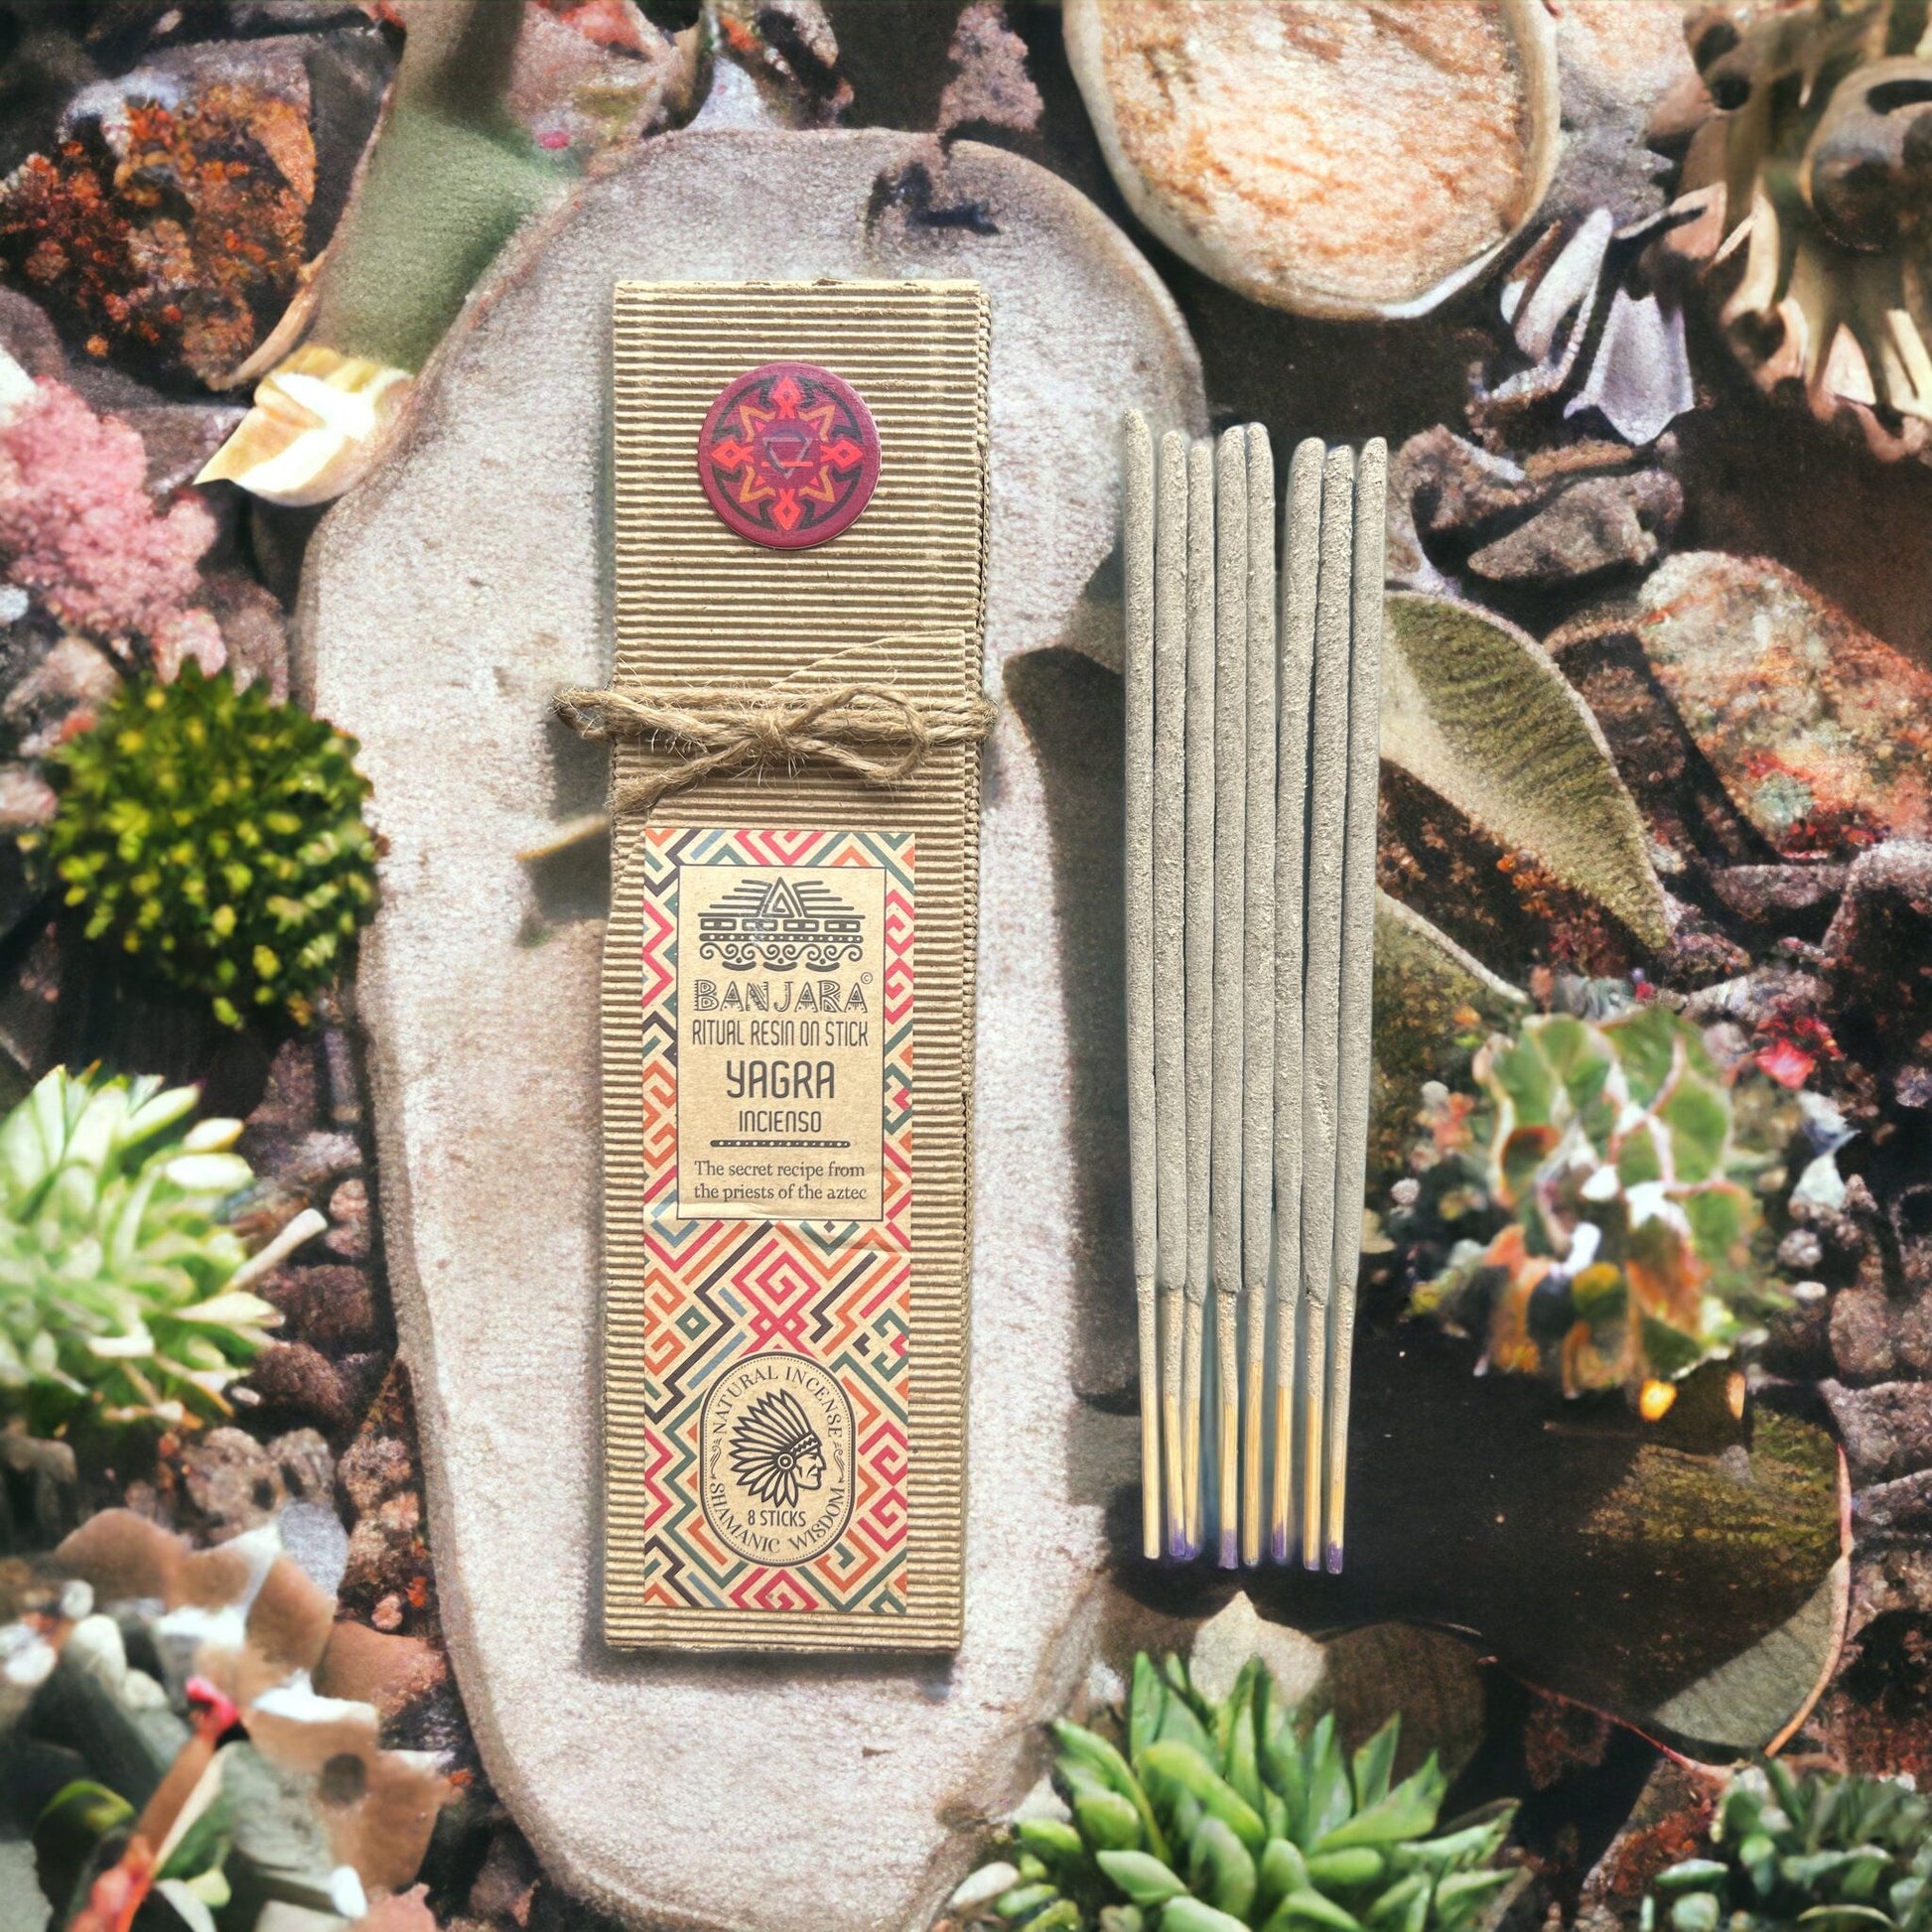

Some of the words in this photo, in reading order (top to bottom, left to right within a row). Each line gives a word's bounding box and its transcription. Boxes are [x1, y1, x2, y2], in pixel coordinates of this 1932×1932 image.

[692, 1019, 745, 1045] RITUAL
[751, 1020, 794, 1045] RESIN
[800, 1020, 820, 1045] ON
[825, 1021, 869, 1047] STICK
[726, 1059, 835, 1099] YAGRA
[739, 1110, 822, 1133] INCIENSO
[694, 1160, 724, 1176] The
[729, 1163, 773, 1176] secret
[777, 1162, 823, 1180] recipe
[828, 1161, 865, 1176] from
[694, 1182, 719, 1199] the
[723, 1183, 774, 1202] priests
[778, 1182, 795, 1199] of
[798, 1182, 822, 1199] the
[827, 1185, 867, 1200] aztec
[713, 1365, 778, 1435] NATURAL
[785, 1366, 843, 1439] INCENSE
[710, 1482, 781, 1554] SHAMANIC
[787, 1487, 845, 1552] WISDOM
[748, 1509, 756, 1526] 8
[760, 1510, 806, 1527] STICKS
